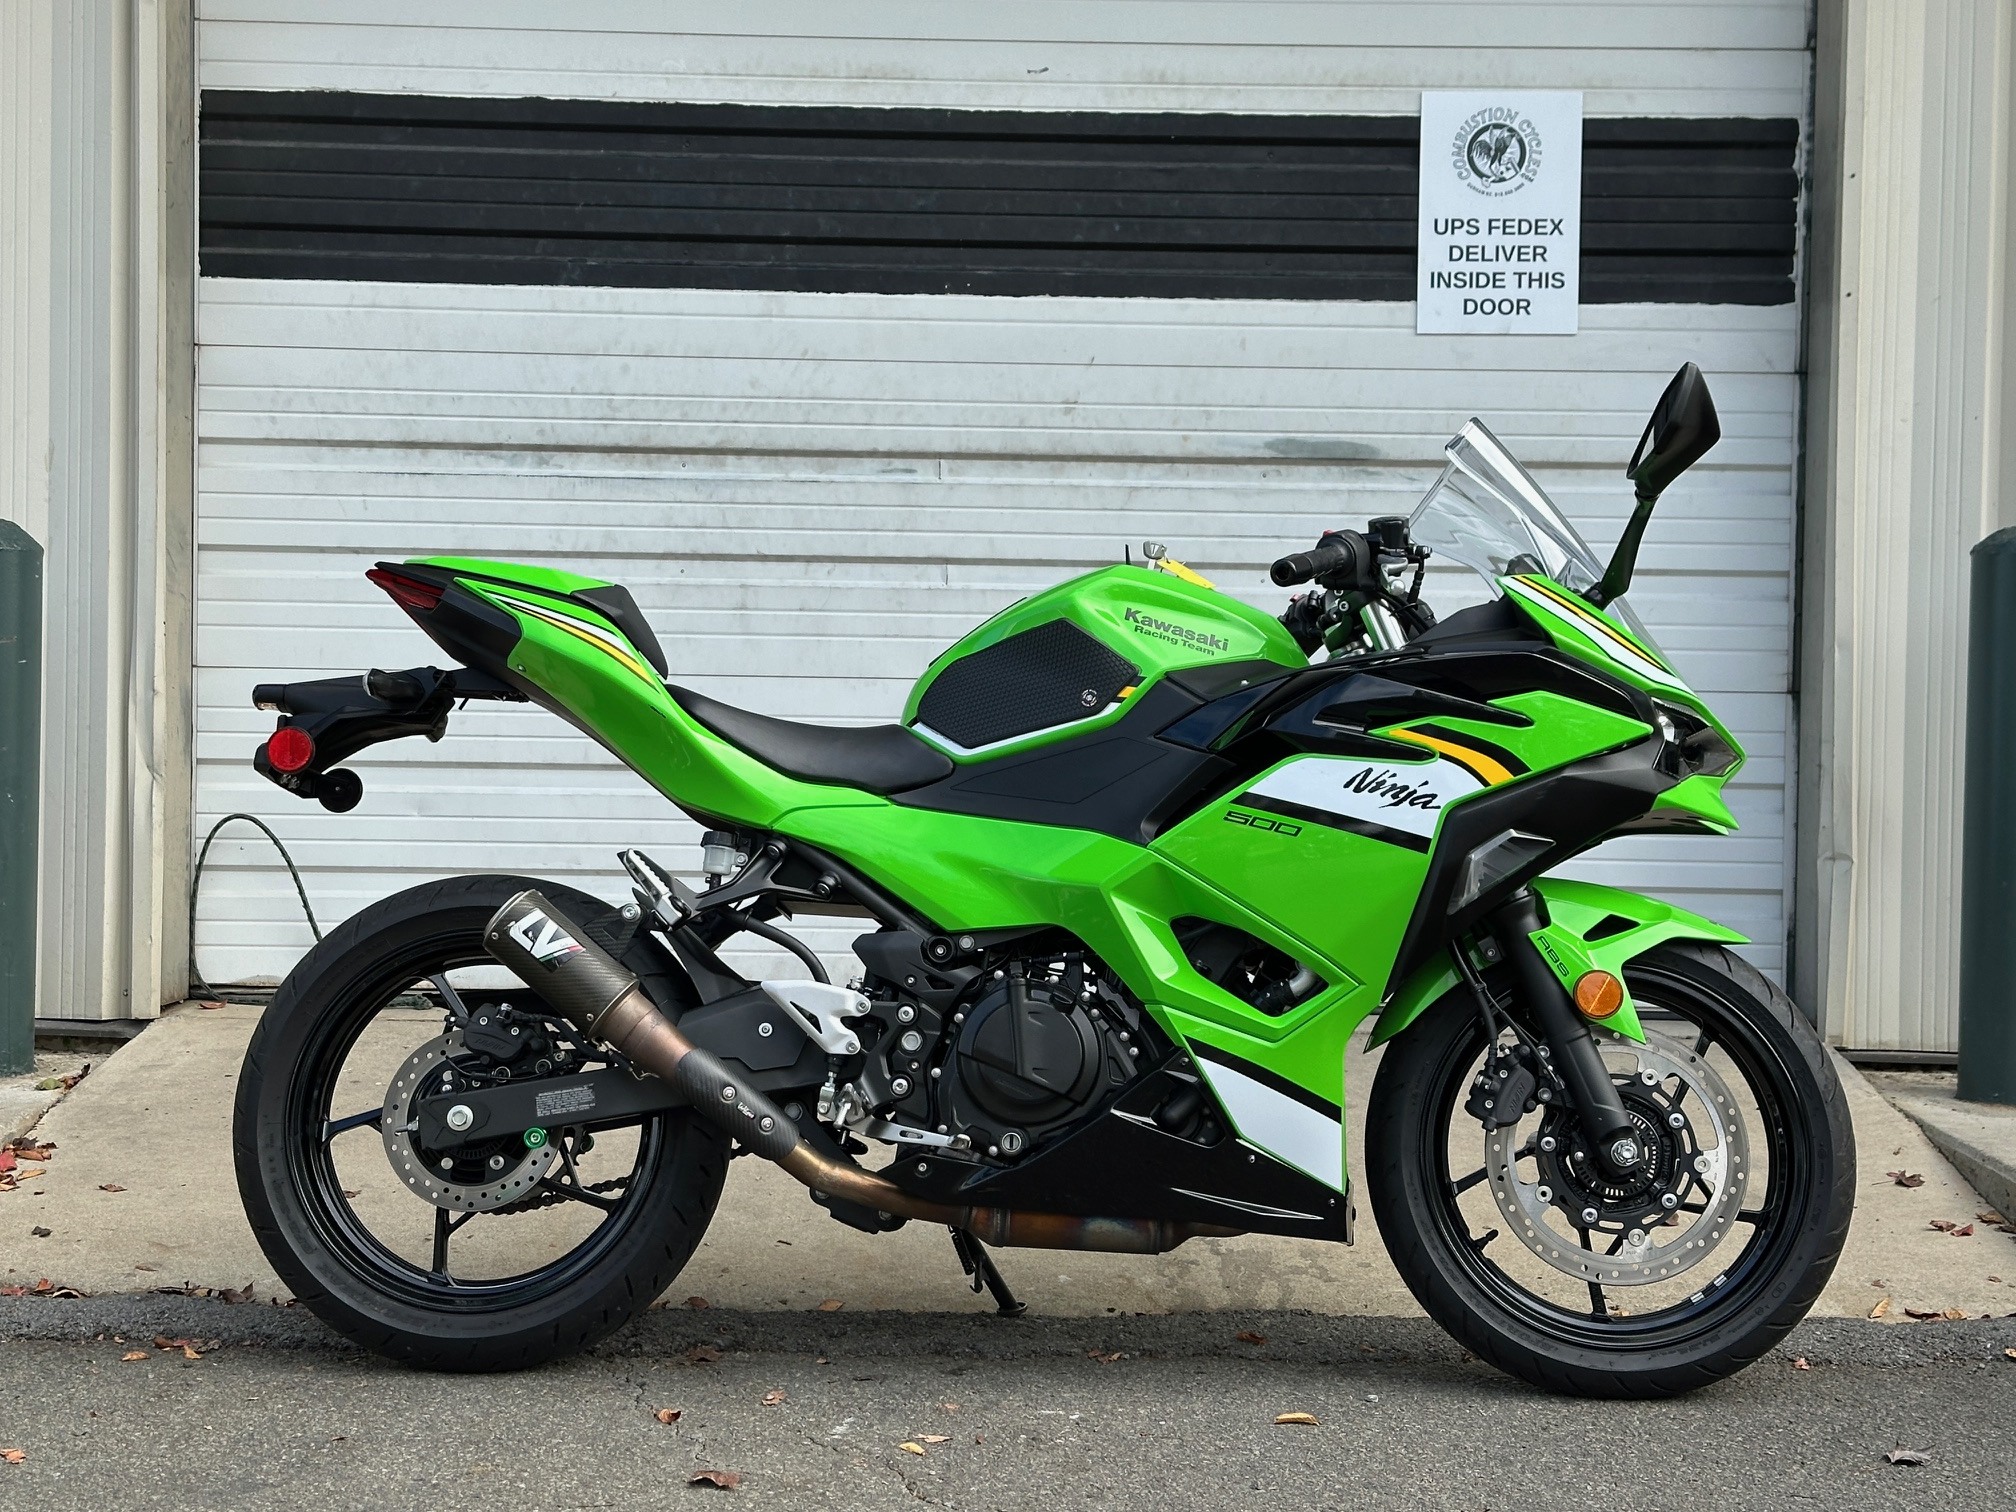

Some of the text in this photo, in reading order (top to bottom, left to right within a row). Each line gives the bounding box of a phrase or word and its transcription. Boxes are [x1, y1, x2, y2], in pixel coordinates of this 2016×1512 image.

[1451, 106, 1519, 180] COMBUSTION
[1518, 119, 1543, 176] CYCLES
[1433, 217, 1564, 236] UPS FEDEX
[1448, 244, 1547, 263] DELIVER
[1430, 271, 1566, 289] INSIDE THIS
[1463, 298, 1531, 316] DOOR
[1124, 607, 1230, 652] Kawasaki
[1133, 624, 1216, 657] Racing Team
[1343, 766, 1442, 810] Ninja
[1222, 809, 1303, 838] 500
[1536, 935, 1570, 978] ABS
